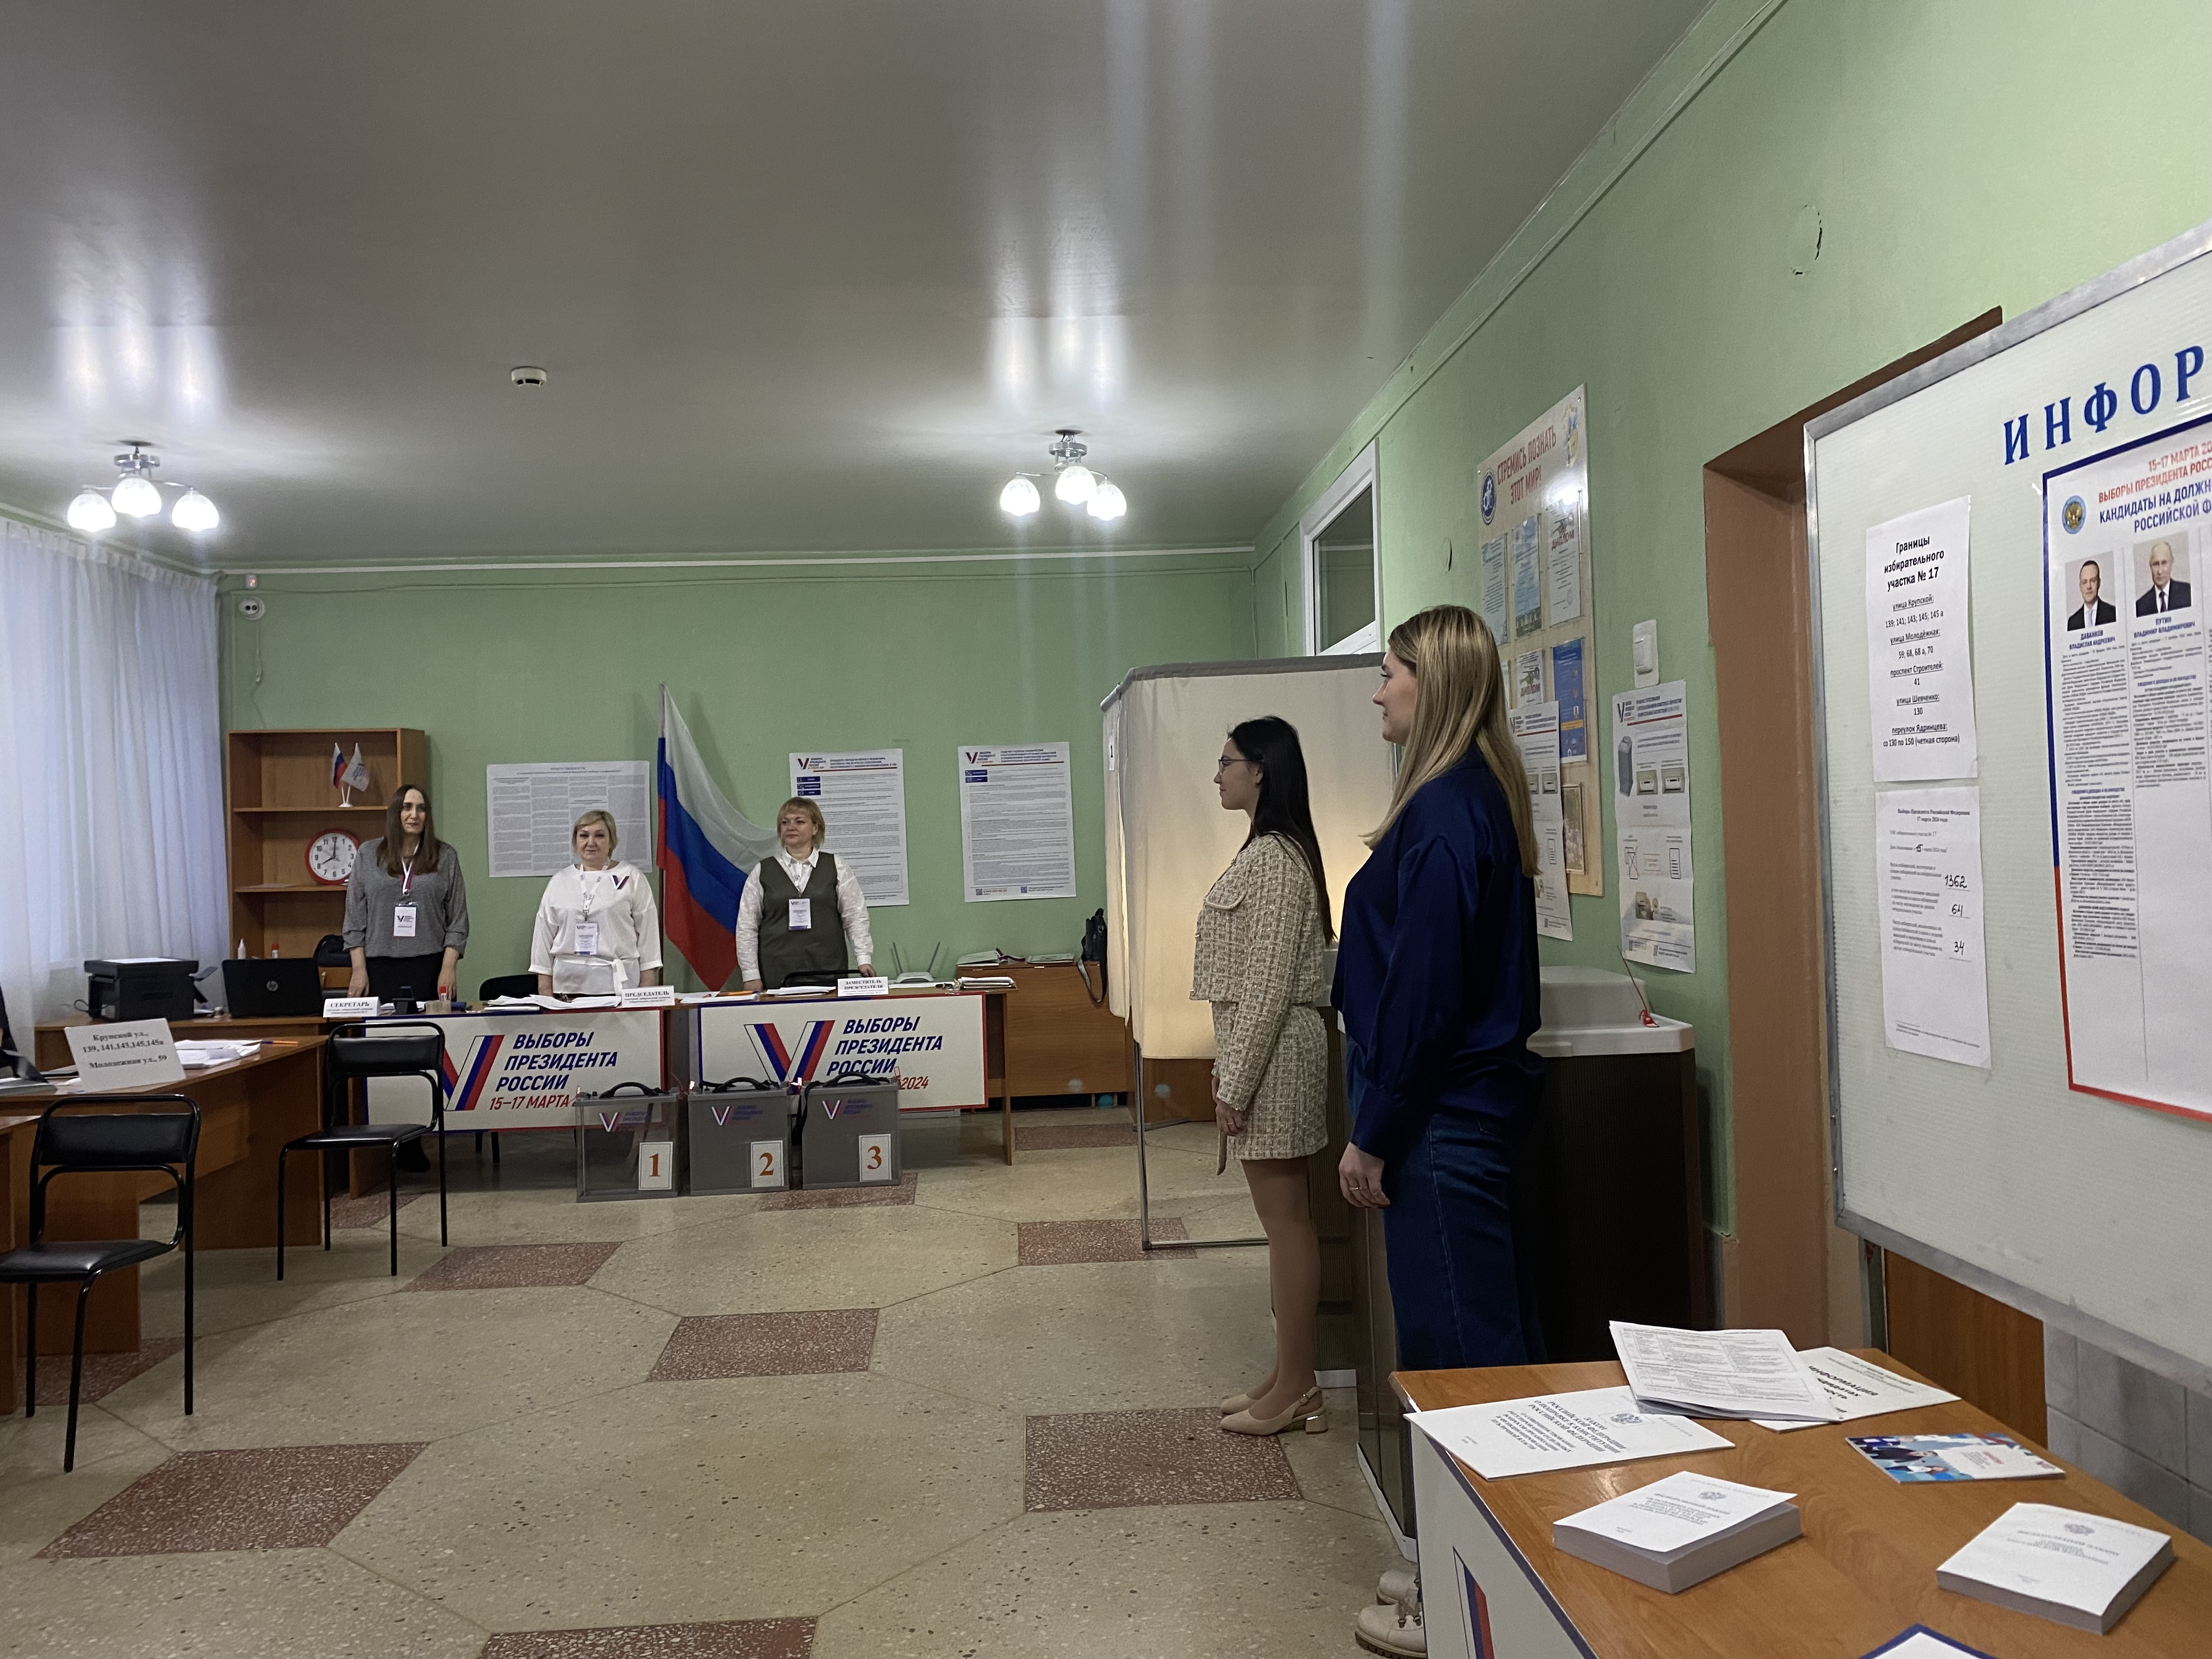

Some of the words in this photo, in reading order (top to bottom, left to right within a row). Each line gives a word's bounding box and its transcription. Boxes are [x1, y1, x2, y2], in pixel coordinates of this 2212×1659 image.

[2004, 346, 2204, 465] ИНФОР
[1497, 446, 1527, 486] СТРЕМИСЬ
[1528, 425, 1556, 464] ПОЗНАТЬ
[2170, 445, 2199, 464] МАРТА
[1510, 477, 1524, 505] ЭТОТ
[2098, 483, 2133, 504] ВЫБОРЫ
[2135, 465, 2188, 492] ПРЕЗИДЕНТА
[2100, 495, 2156, 524] КАНДИДАТЫ
[2159, 492, 2171, 507] НА
[2174, 478, 2211, 505] ДОЛЖН
[2134, 499, 2199, 533] РОССИЙСКОЙ
[1896, 536, 1930, 554] Границы
[1884, 550, 1944, 573] избирательного
[1888, 575, 1915, 592] участка
[1918, 571, 1926, 582] №
[1929, 567, 1939, 579] 17
[1893, 602, 1908, 611] улица
[1908, 594, 1934, 608] Крупской:
[1886, 619, 1895, 628] 139;
[1897, 617, 1906, 627] 141;
[1908, 615, 1918, 624] 143;
[1919, 613, 1929, 622] 145;
[1931, 610, 1939, 618] 145
[2155, 617, 2171, 626] ПУТИН
[1891, 635, 1905, 645] улица
[2081, 630, 2103, 641] ДАВАНКОВ
[1927, 646, 1933, 654] 70
[1891, 667, 1912, 678] проспект
[1913, 662, 1943, 675] Строителей:
[1897, 697, 1911, 706] улица
[1914, 707, 1923, 715] 130
[1892, 726, 1915, 736] переулок
[1936, 733, 1960, 744] сторона)
[1945, 874, 1967, 888] 1362
[1951, 904, 1963, 916] 64
[1954, 940, 1965, 955] 34
[843, 1017, 921, 1034] ВЫБОРЫ
[513, 1032, 594, 1049] ВЫБОРЫ
[834, 1036, 943, 1055] ПРЕЗИДЕНТА
[504, 1052, 617, 1071] ПРЕЗИДЕНТА
[826, 1058, 897, 1076] РОССИИ
[495, 1074, 569, 1092] РОССИИ
[900, 1076, 929, 1090] 2024
[526, 1094, 569, 1109] МАРТА
[649, 1153, 661, 1177] 1
[759, 1152, 774, 1176] 2
[867, 1146, 882, 1169] 3
[1809, 1366, 1878, 1396] ИНФОРМАЦИЯ
